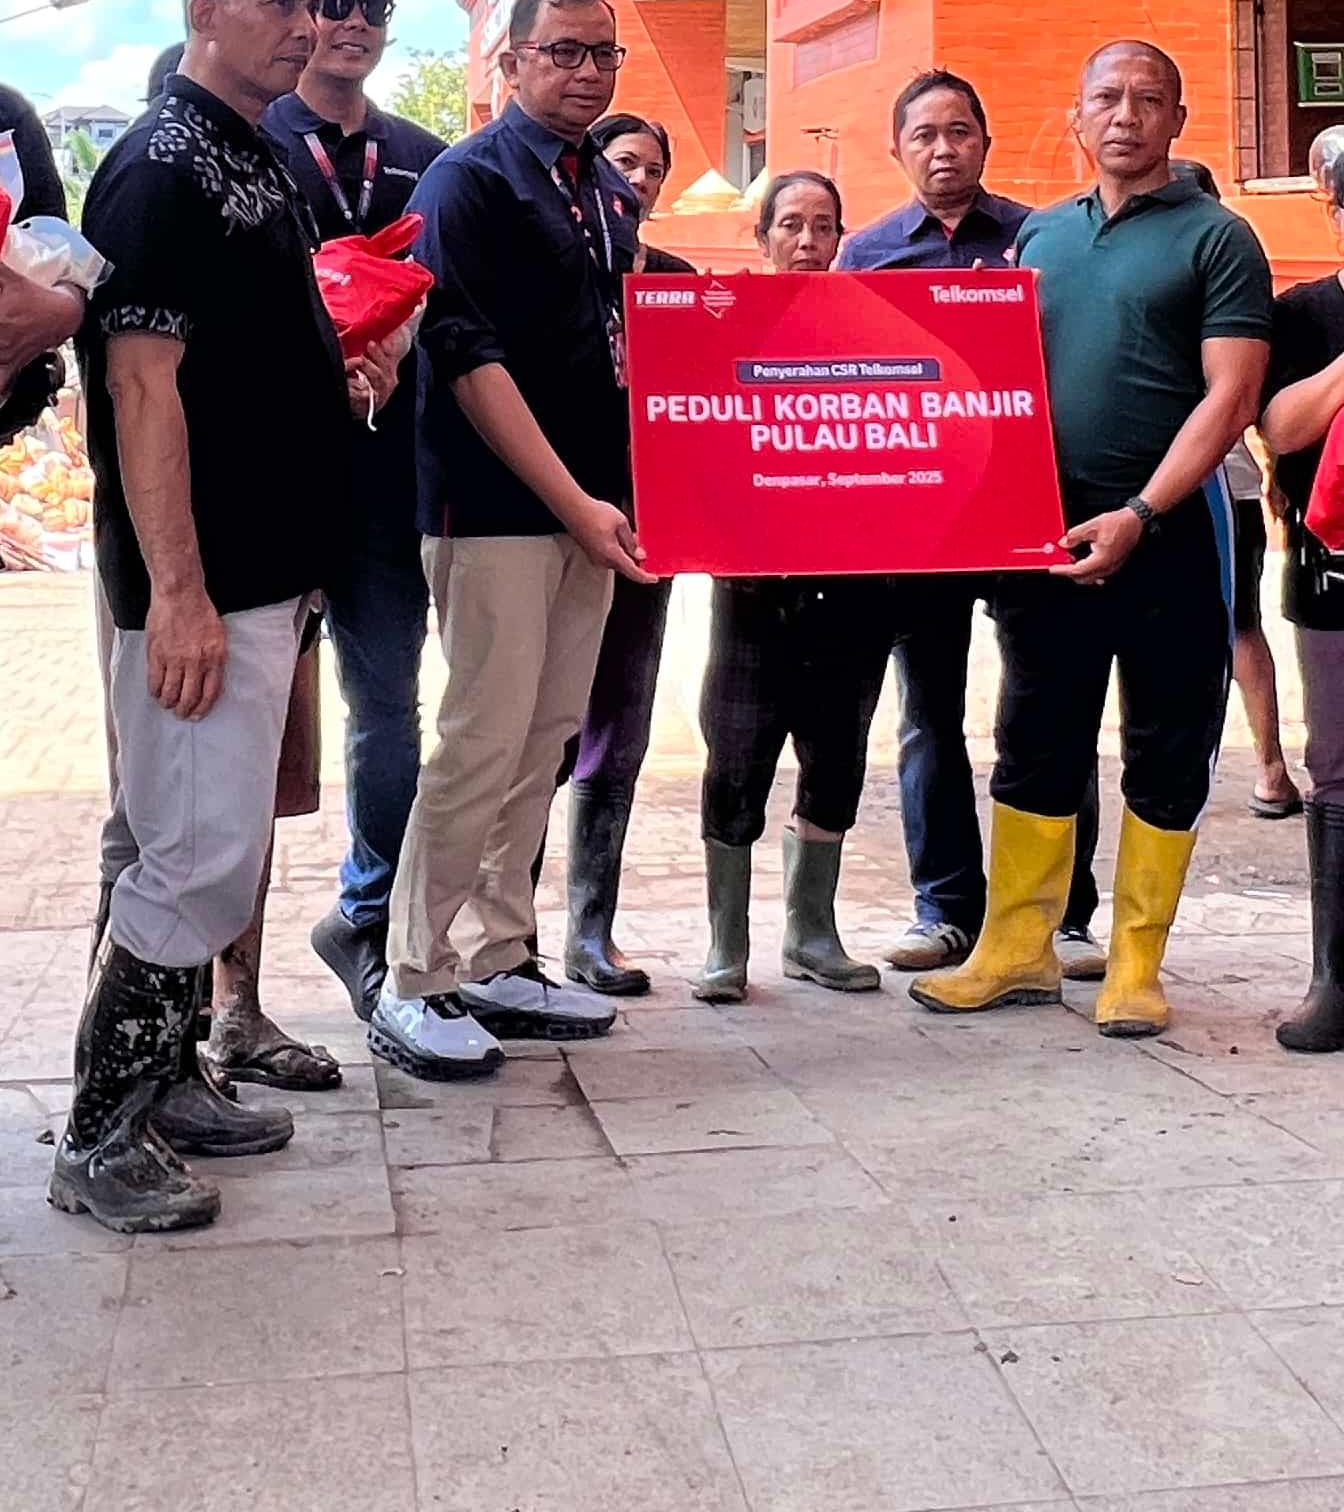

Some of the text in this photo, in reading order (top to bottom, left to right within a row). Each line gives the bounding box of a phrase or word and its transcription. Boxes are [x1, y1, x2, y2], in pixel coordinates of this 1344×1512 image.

[929, 284, 1024, 303] Telkomsel
[753, 362, 923, 379] Penyerahan CSR Telkomsel
[646, 390, 1035, 422] PEDULI KORBAN BANJIR
[750, 422, 939, 451] PULAU BALI
[752, 470, 944, 488] Denpasar, September 2025
